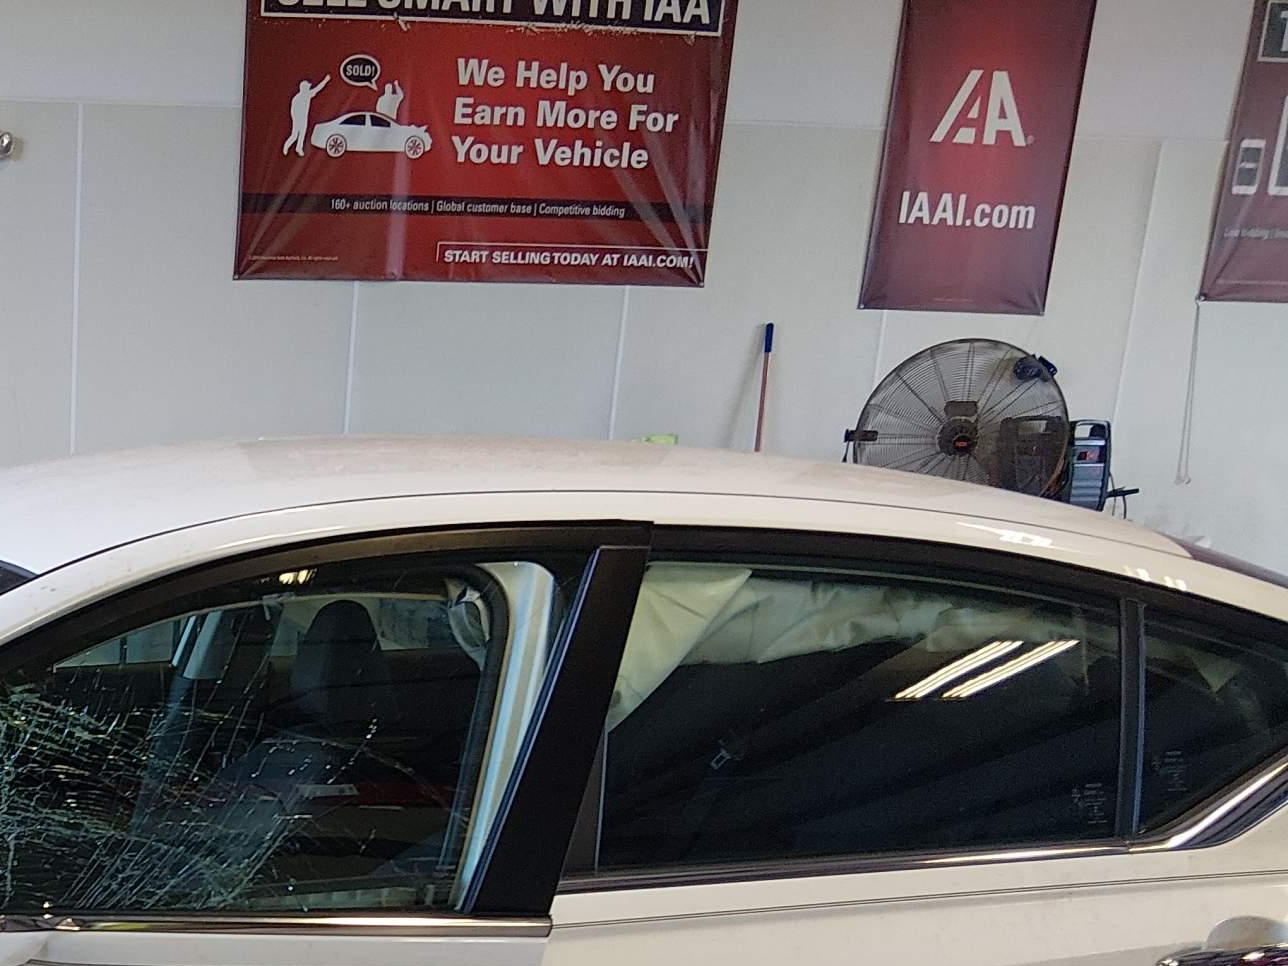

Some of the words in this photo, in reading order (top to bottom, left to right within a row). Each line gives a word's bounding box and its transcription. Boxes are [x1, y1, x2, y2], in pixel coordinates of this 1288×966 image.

[346, 64, 375, 77] SOLD!
[457, 58, 505, 87] We
[515, 60, 588, 96] Help
[598, 64, 655, 93] You
[453, 97, 525, 126] Earn
[536, 100, 617, 130] More
[628, 104, 679, 133] For
[451, 135, 523, 165] Your
[534, 138, 649, 169] Vehicle
[330, 198, 350, 210] 160+
[353, 199, 388, 211] auction
[389, 199, 429, 212] locations
[436, 200, 465, 212] Global
[466, 202, 508, 213] customer
[510, 202, 532, 214] base
[539, 203, 591, 217] Competitive
[592, 204, 626, 219] bidding
[898, 190, 1035, 229] IAAI.com
[444, 250, 489, 263] START
[492, 252, 554, 265] SELLING
[553, 253, 599, 266] TODAY
[601, 254, 620, 266] AT
[622, 254, 694, 268] IAAI.COM!
